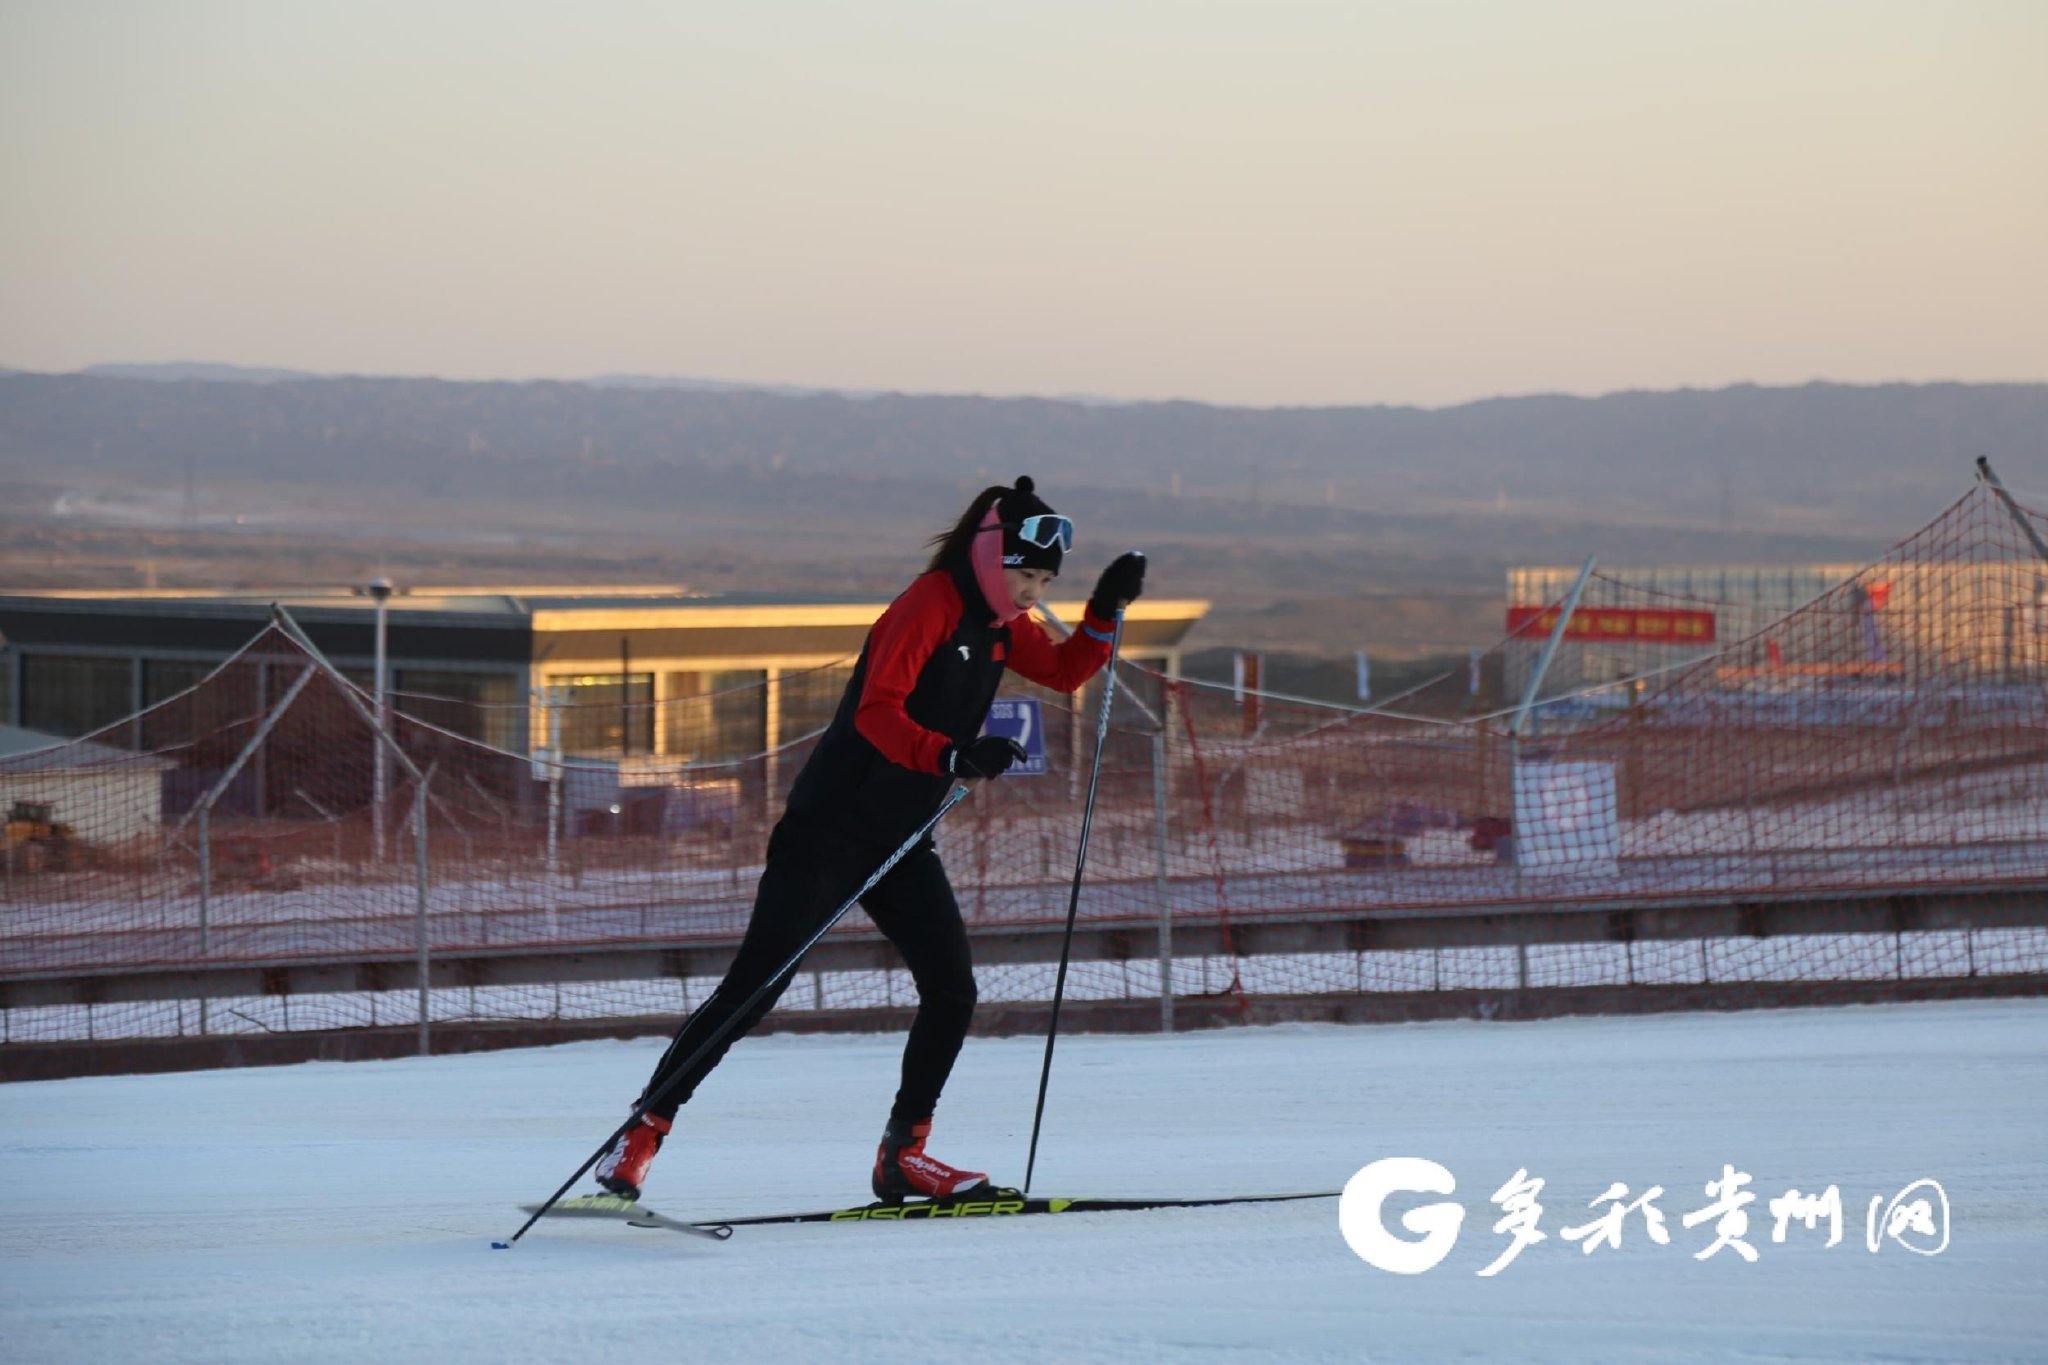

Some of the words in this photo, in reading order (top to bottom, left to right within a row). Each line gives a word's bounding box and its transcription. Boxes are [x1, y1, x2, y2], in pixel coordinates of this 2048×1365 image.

[1001, 553, 1025, 565] wix
[904, 1155, 951, 1178] alpina
[831, 1201, 1025, 1222] FISCHER
